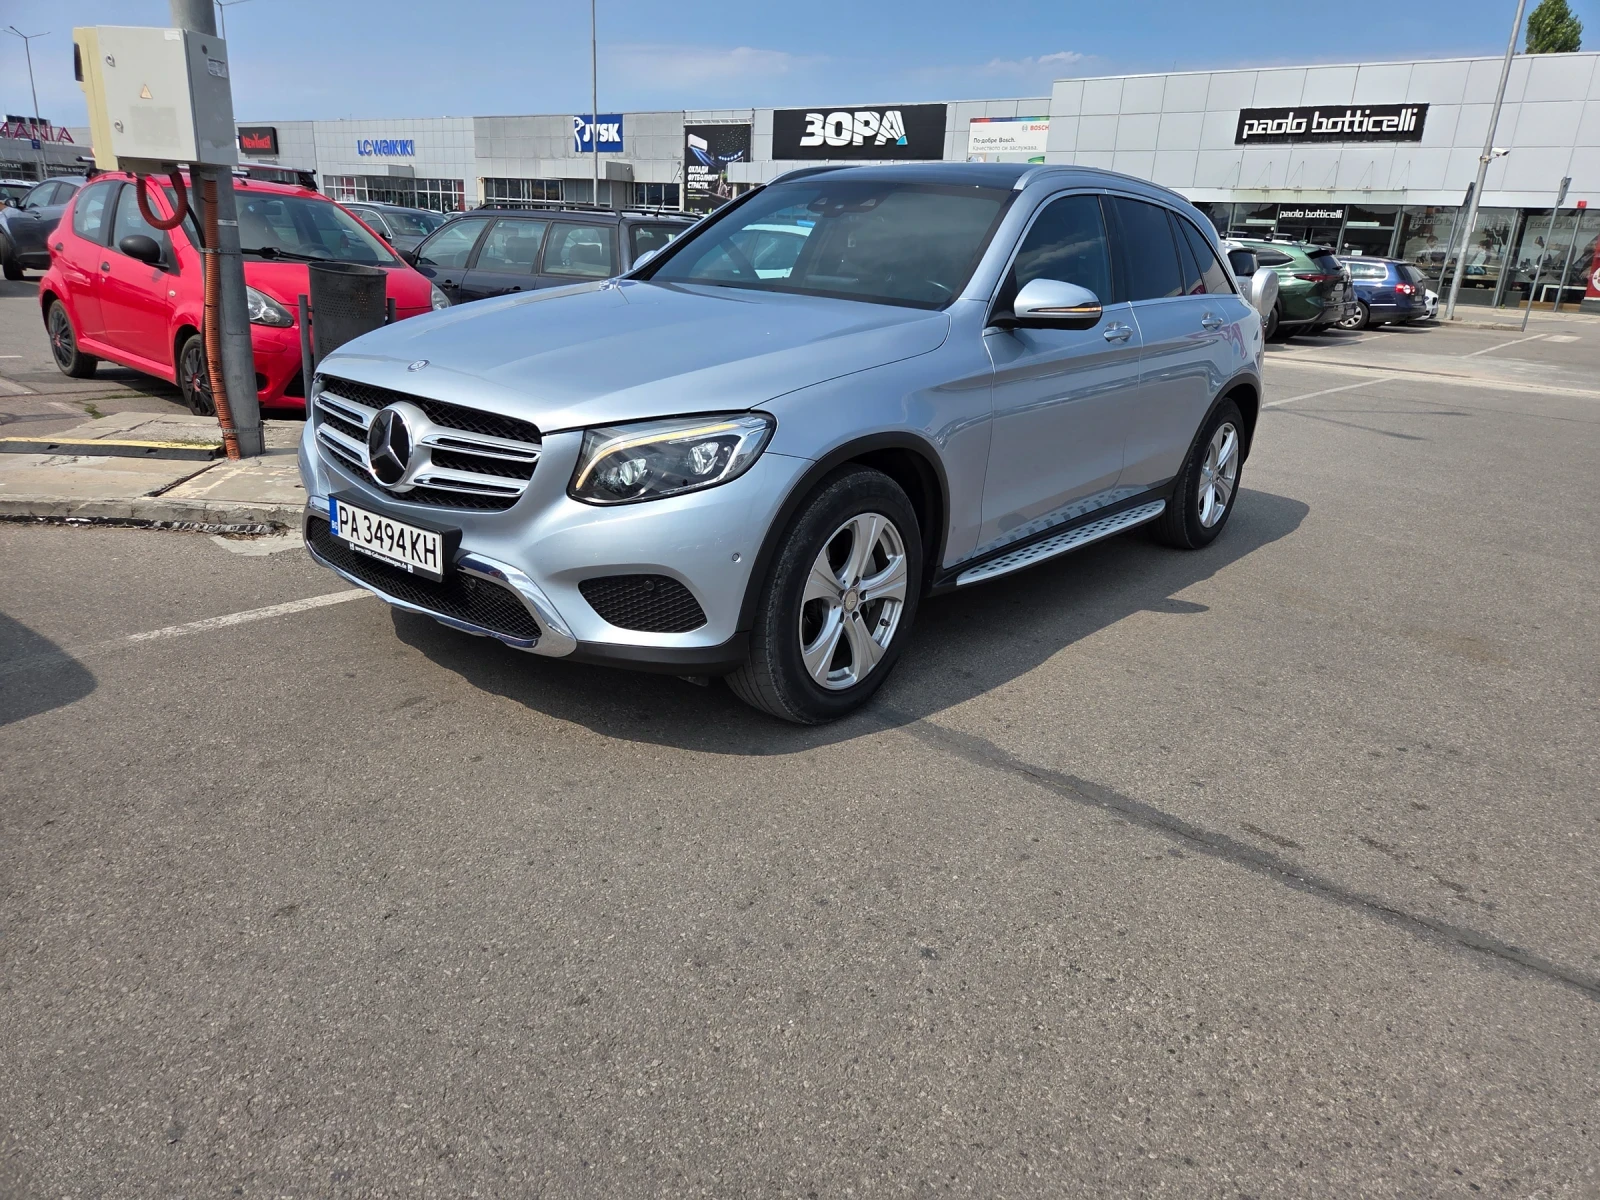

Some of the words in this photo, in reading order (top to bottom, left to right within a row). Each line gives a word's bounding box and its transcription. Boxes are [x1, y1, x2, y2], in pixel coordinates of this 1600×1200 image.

[583, 123, 621, 142] JYSK
[799, 110, 908, 146] ЗОРА
[1242, 111, 1307, 139] paolo
[1311, 108, 1418, 133] botticelli
[1279, 208, 1304, 219] paolo
[1304, 208, 1344, 219] botticelli
